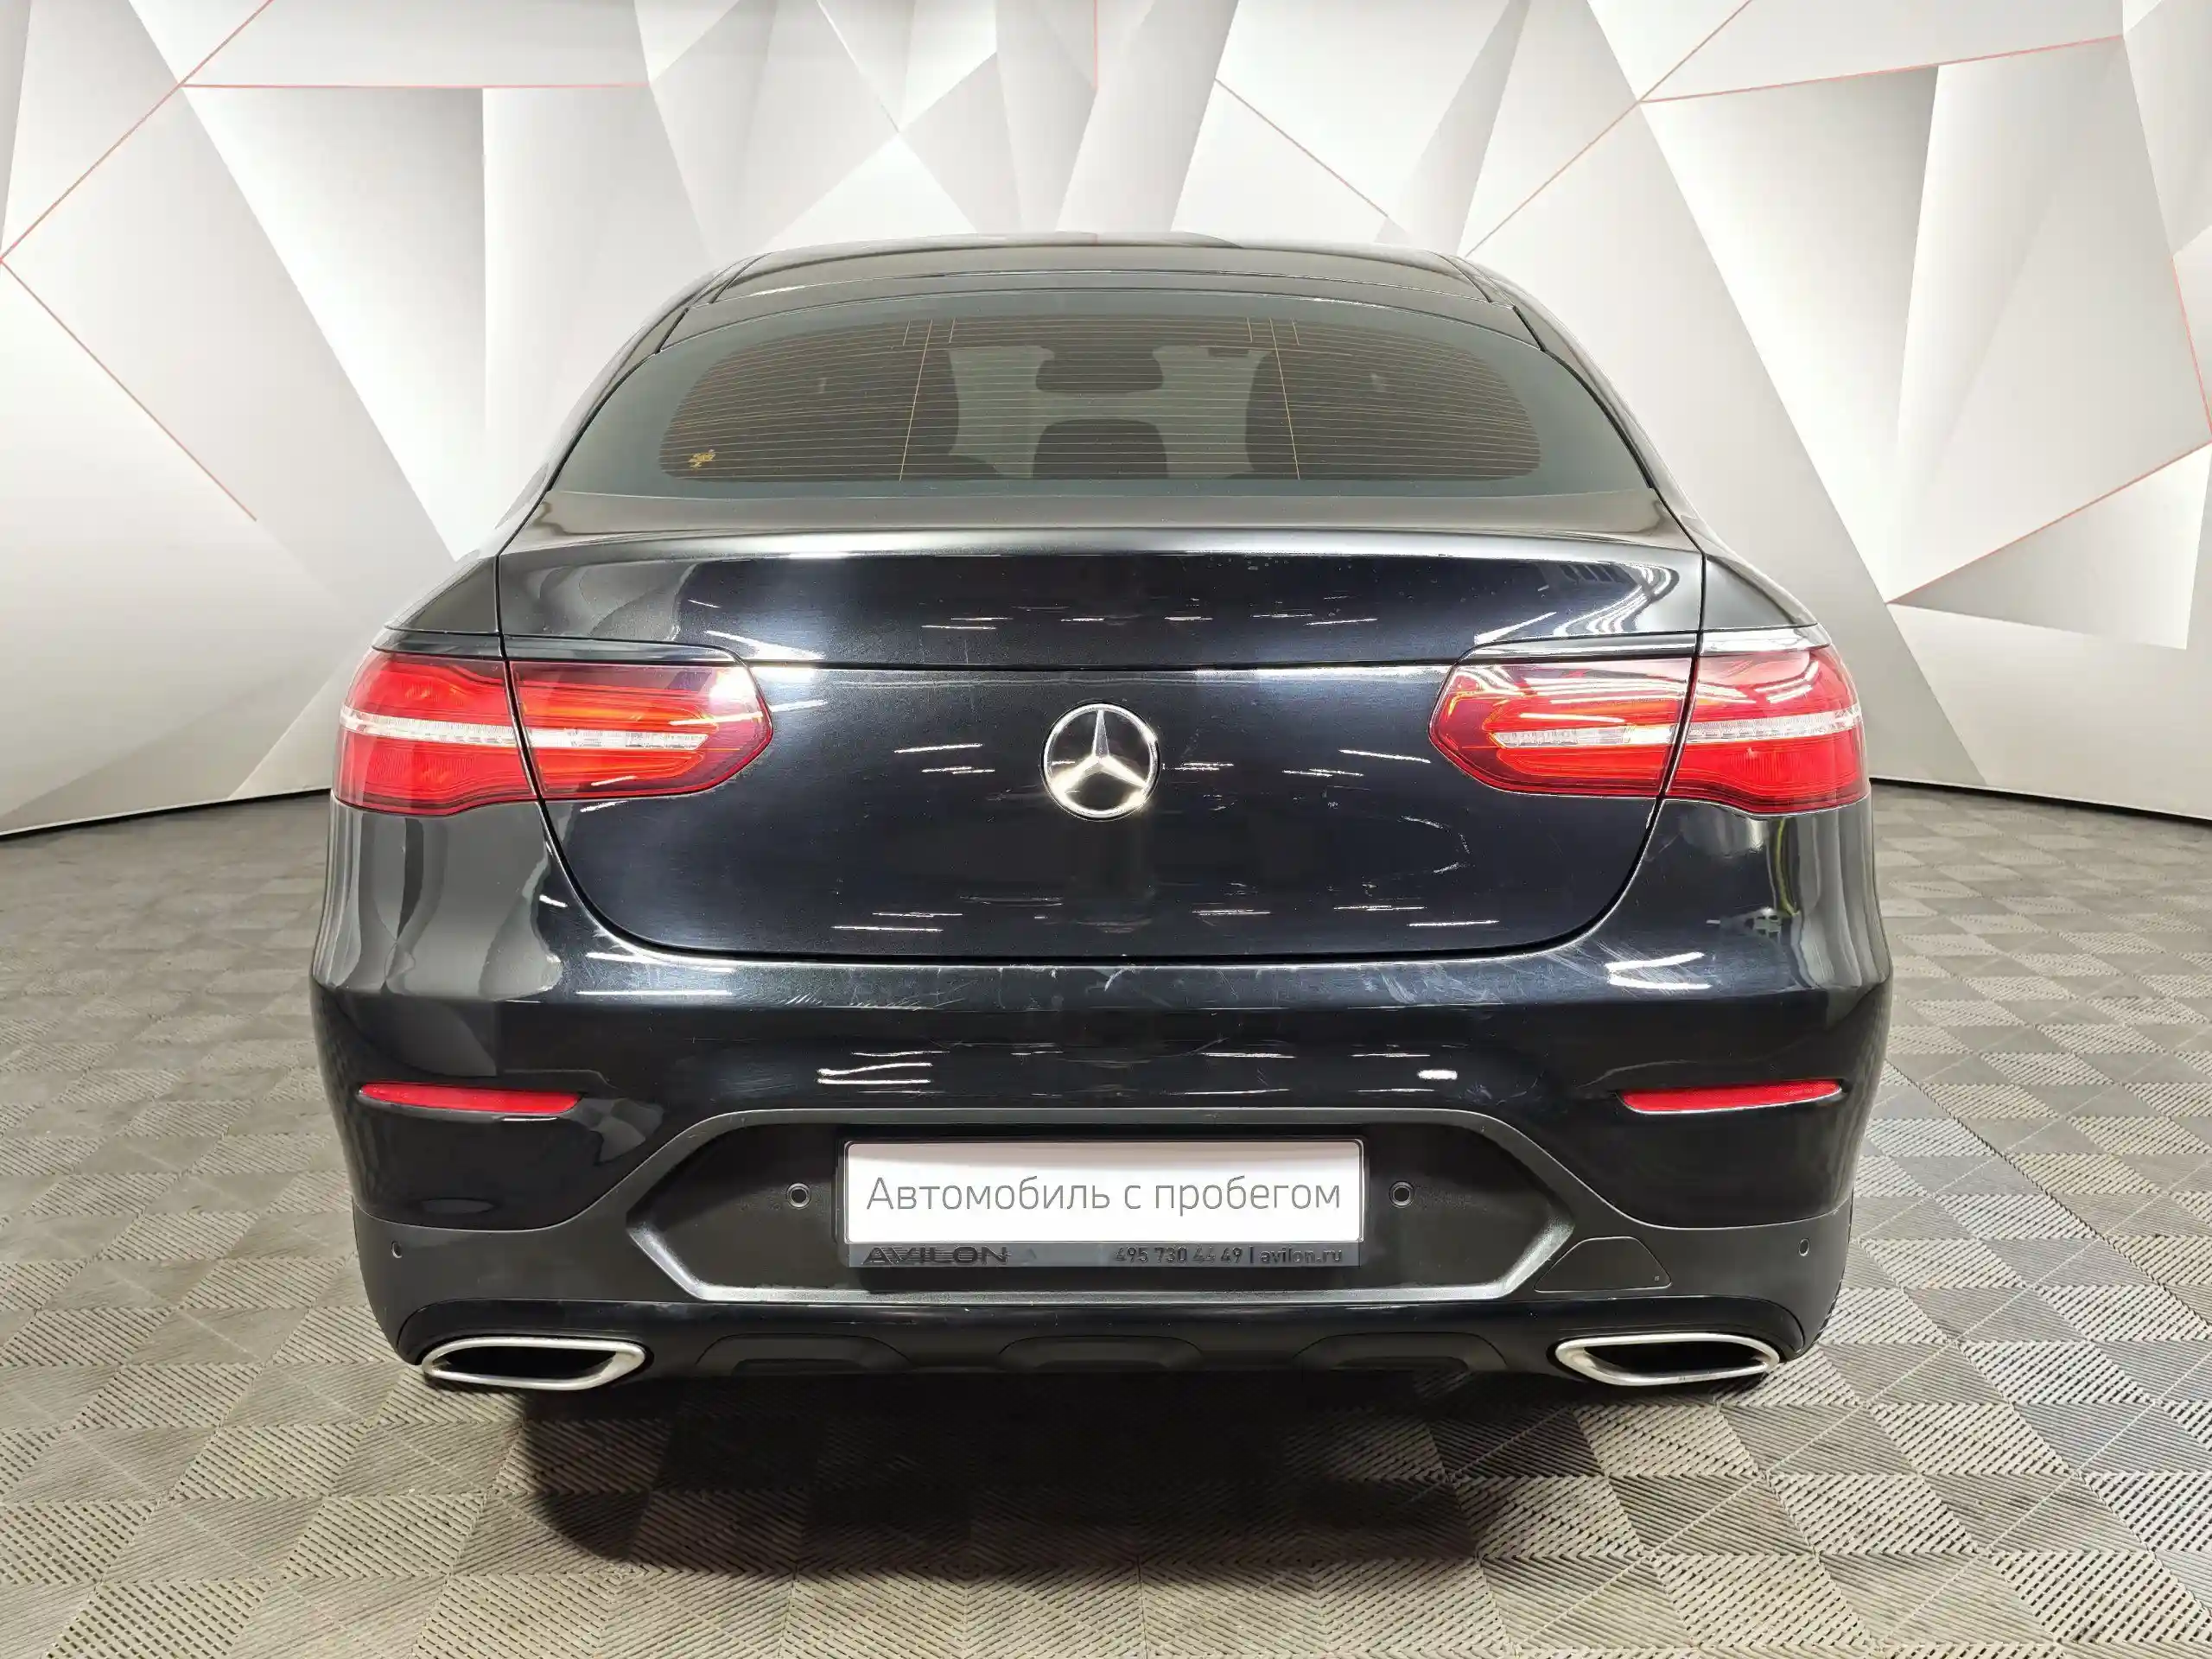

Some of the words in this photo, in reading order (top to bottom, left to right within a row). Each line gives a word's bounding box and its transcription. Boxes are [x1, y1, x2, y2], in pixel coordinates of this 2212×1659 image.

[867, 1175, 1111, 1210] Автомобиль
[1124, 1185, 1141, 1210] с
[1155, 1175, 1340, 1217] пробегом
[861, 1245, 1011, 1265] AVILON
[1115, 1247, 1148, 1264] 495
[1154, 1247, 1188, 1264] 730
[1220, 1247, 1243, 1264] 49
[1259, 1246, 1343, 1264] avilon.ru
